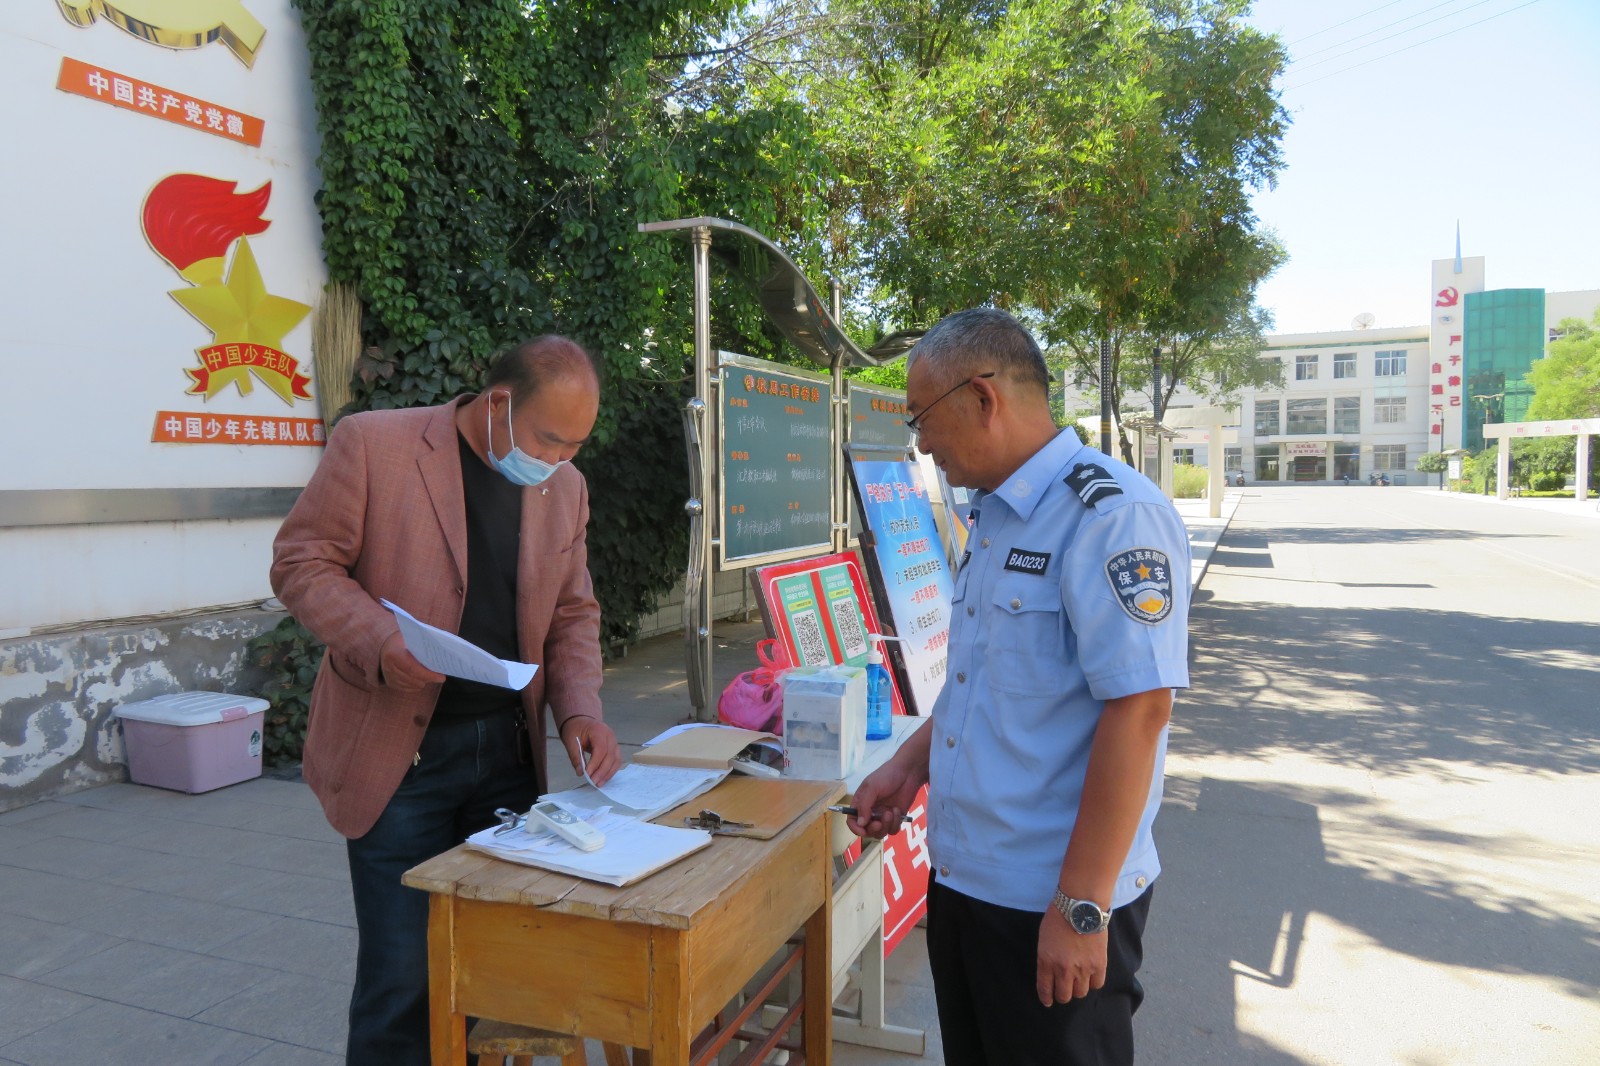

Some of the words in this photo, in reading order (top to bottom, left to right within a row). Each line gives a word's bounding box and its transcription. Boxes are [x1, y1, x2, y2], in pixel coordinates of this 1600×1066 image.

[88, 71, 245, 138] 中国共产党党徽
[206, 345, 291, 376] 中国少先队
[165, 415, 327, 442] 中国少年先锋队队徽
[1009, 553, 1046, 570] BA0233
[1110, 551, 1166, 572] 中华人民共和国
[1118, 570, 1133, 586] 保
[1154, 566, 1166, 580] 安
